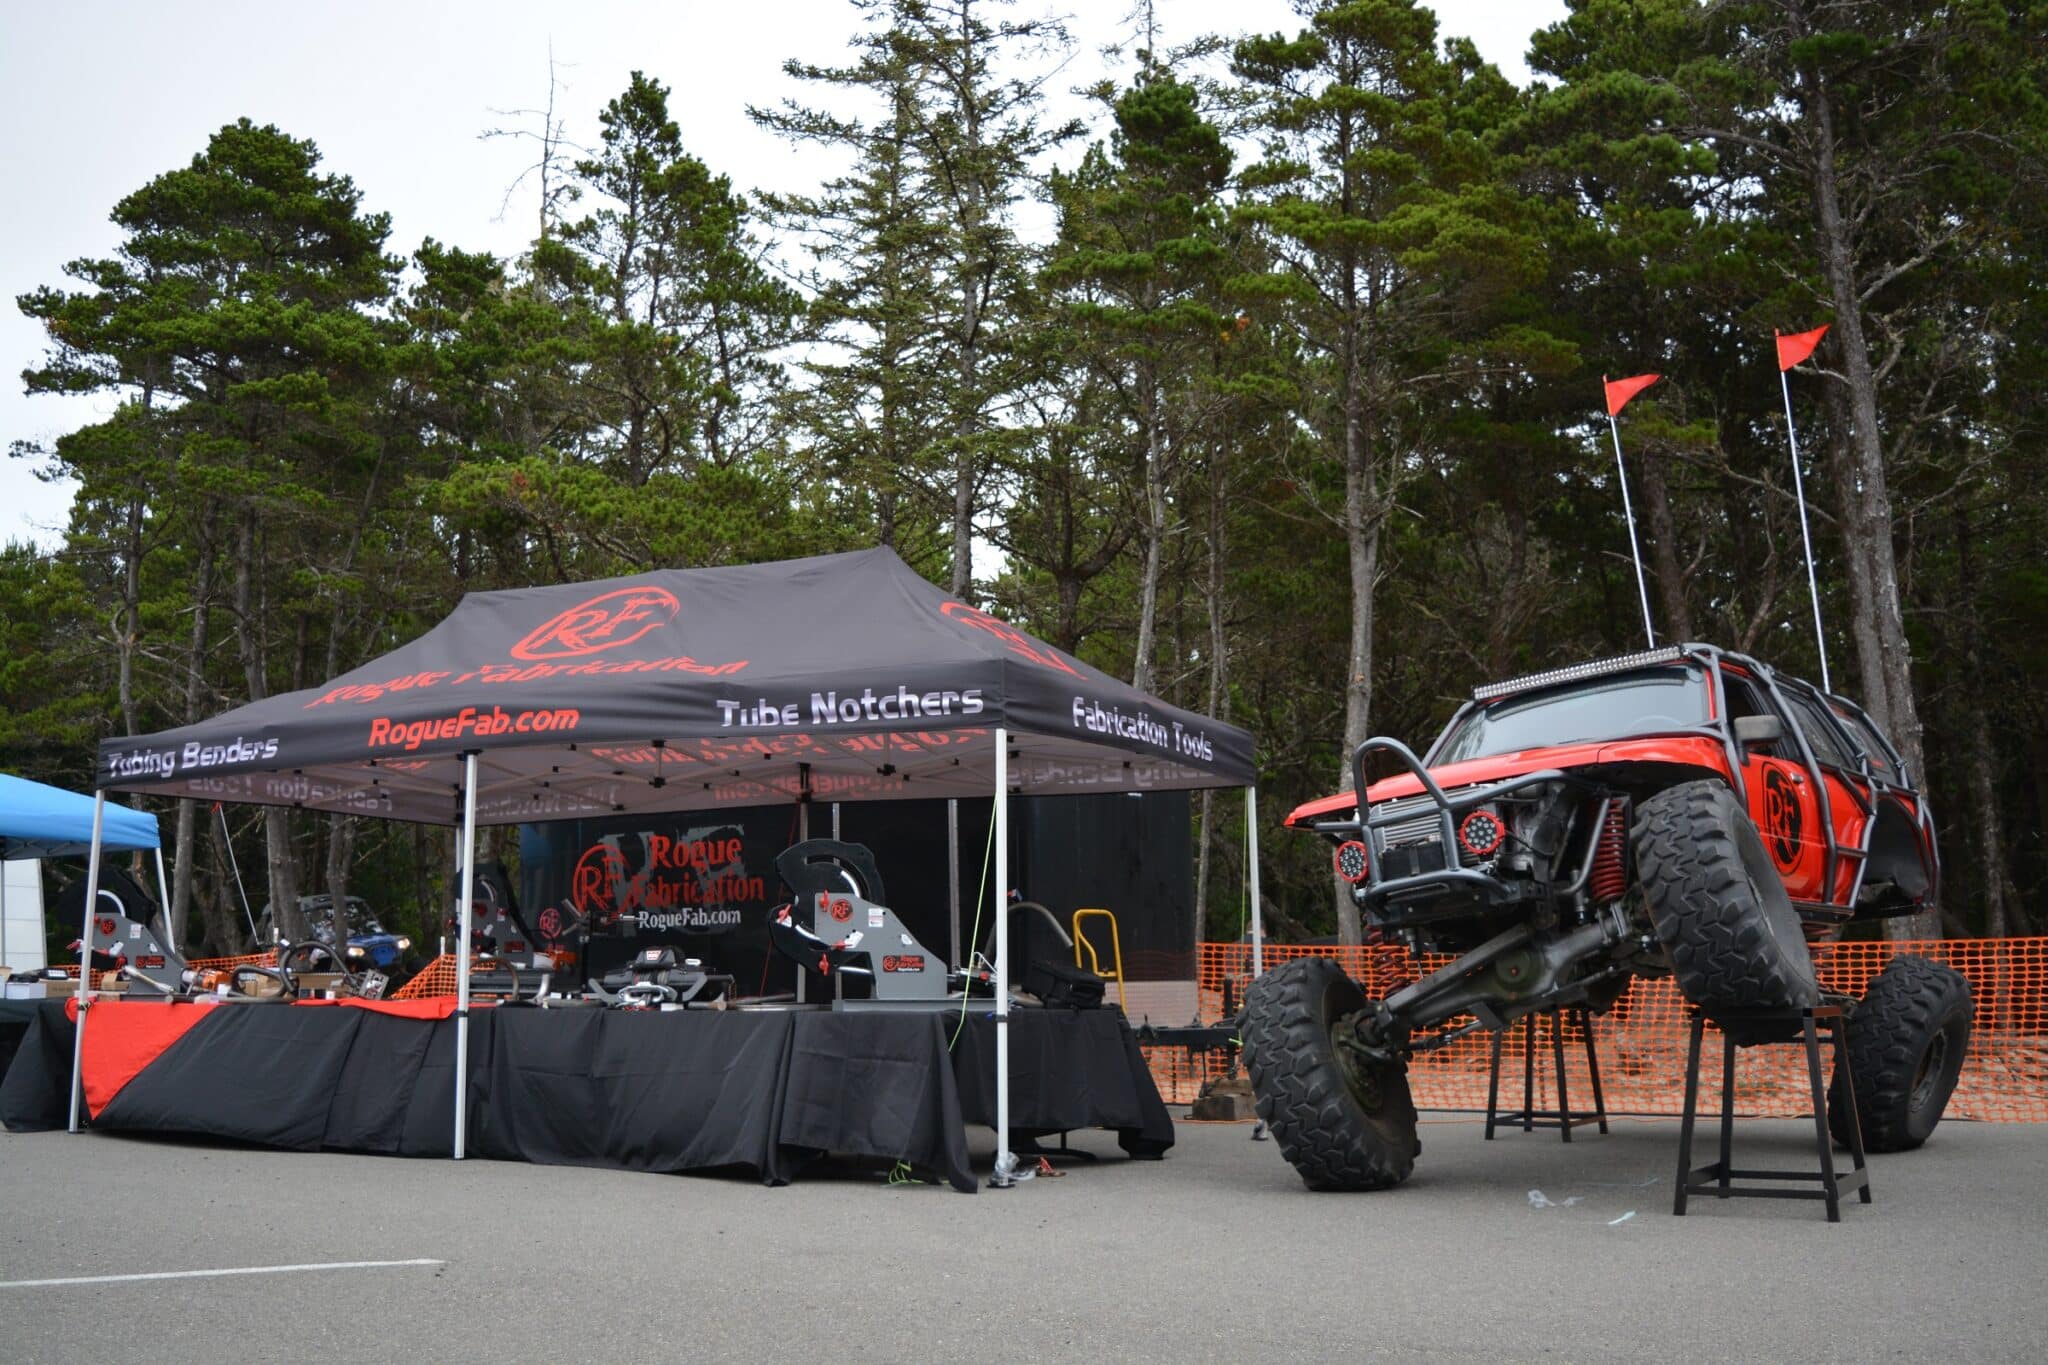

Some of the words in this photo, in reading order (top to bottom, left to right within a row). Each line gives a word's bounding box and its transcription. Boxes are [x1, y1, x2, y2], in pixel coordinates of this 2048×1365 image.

[304, 672, 451, 708] Rogue
[452, 656, 748, 684] Fabrication
[368, 705, 579, 750] RogueFab.com
[717, 699, 799, 727] Tube
[811, 686, 984, 724] Notchers
[1072, 696, 1168, 748] Fabrication
[1172, 722, 1213, 762] Tools
[108, 749, 176, 778] Tubing
[182, 737, 279, 769] Benders
[650, 836, 742, 876] Rogue
[622, 869, 766, 912] Fabrication
[639, 907, 741, 931] RogueFab.com
